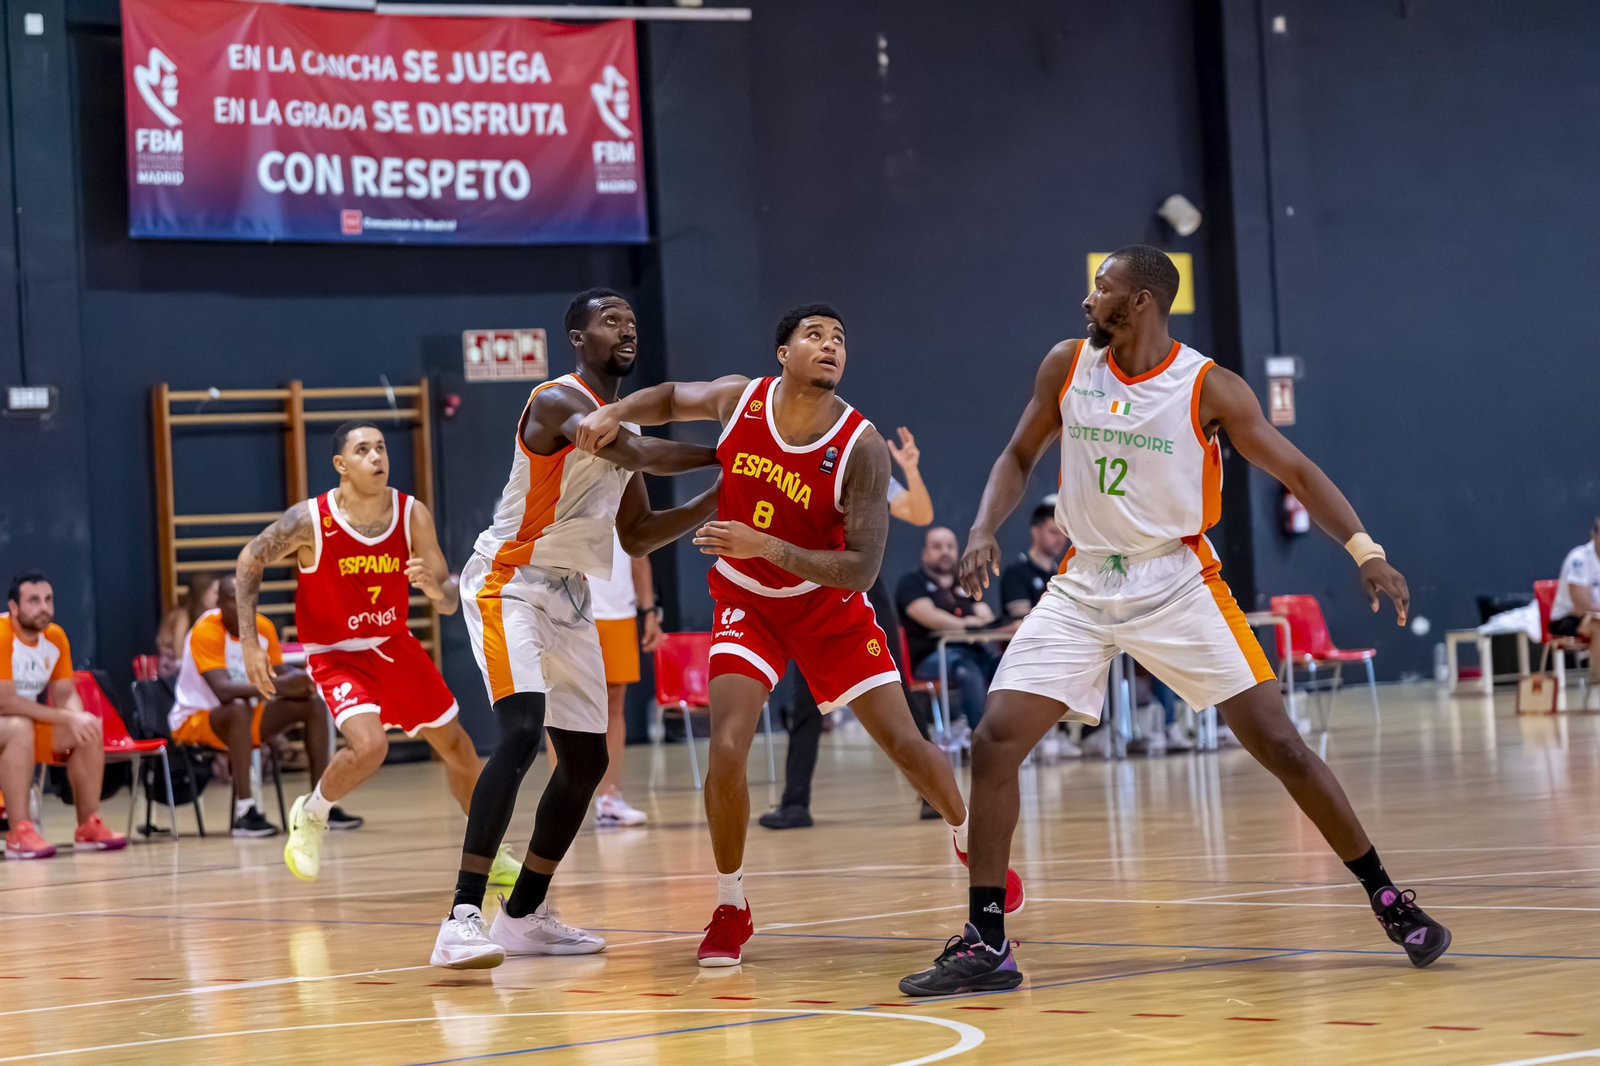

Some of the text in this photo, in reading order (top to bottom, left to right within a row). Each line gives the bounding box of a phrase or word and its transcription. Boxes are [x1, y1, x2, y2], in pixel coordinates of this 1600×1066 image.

[228, 44, 552, 84] EN LA CANCHA SE JUEGA
[214, 96, 568, 136] EN LA GRADA SE DISFRUTA
[135, 128, 184, 153] FBM
[592, 140, 635, 164] FBM
[137, 170, 184, 185] MADRID
[257, 150, 531, 201] CON RESPETO
[596, 178, 637, 194] MADRID
[1068, 422, 1175, 455] CÔTE D'IVOIRE
[731, 452, 812, 510] ESPAÑA
[1094, 456, 1128, 496] 12
[753, 500, 774, 529] 8
[338, 553, 400, 577] ESPAÑA
[367, 586, 382, 604] 7
